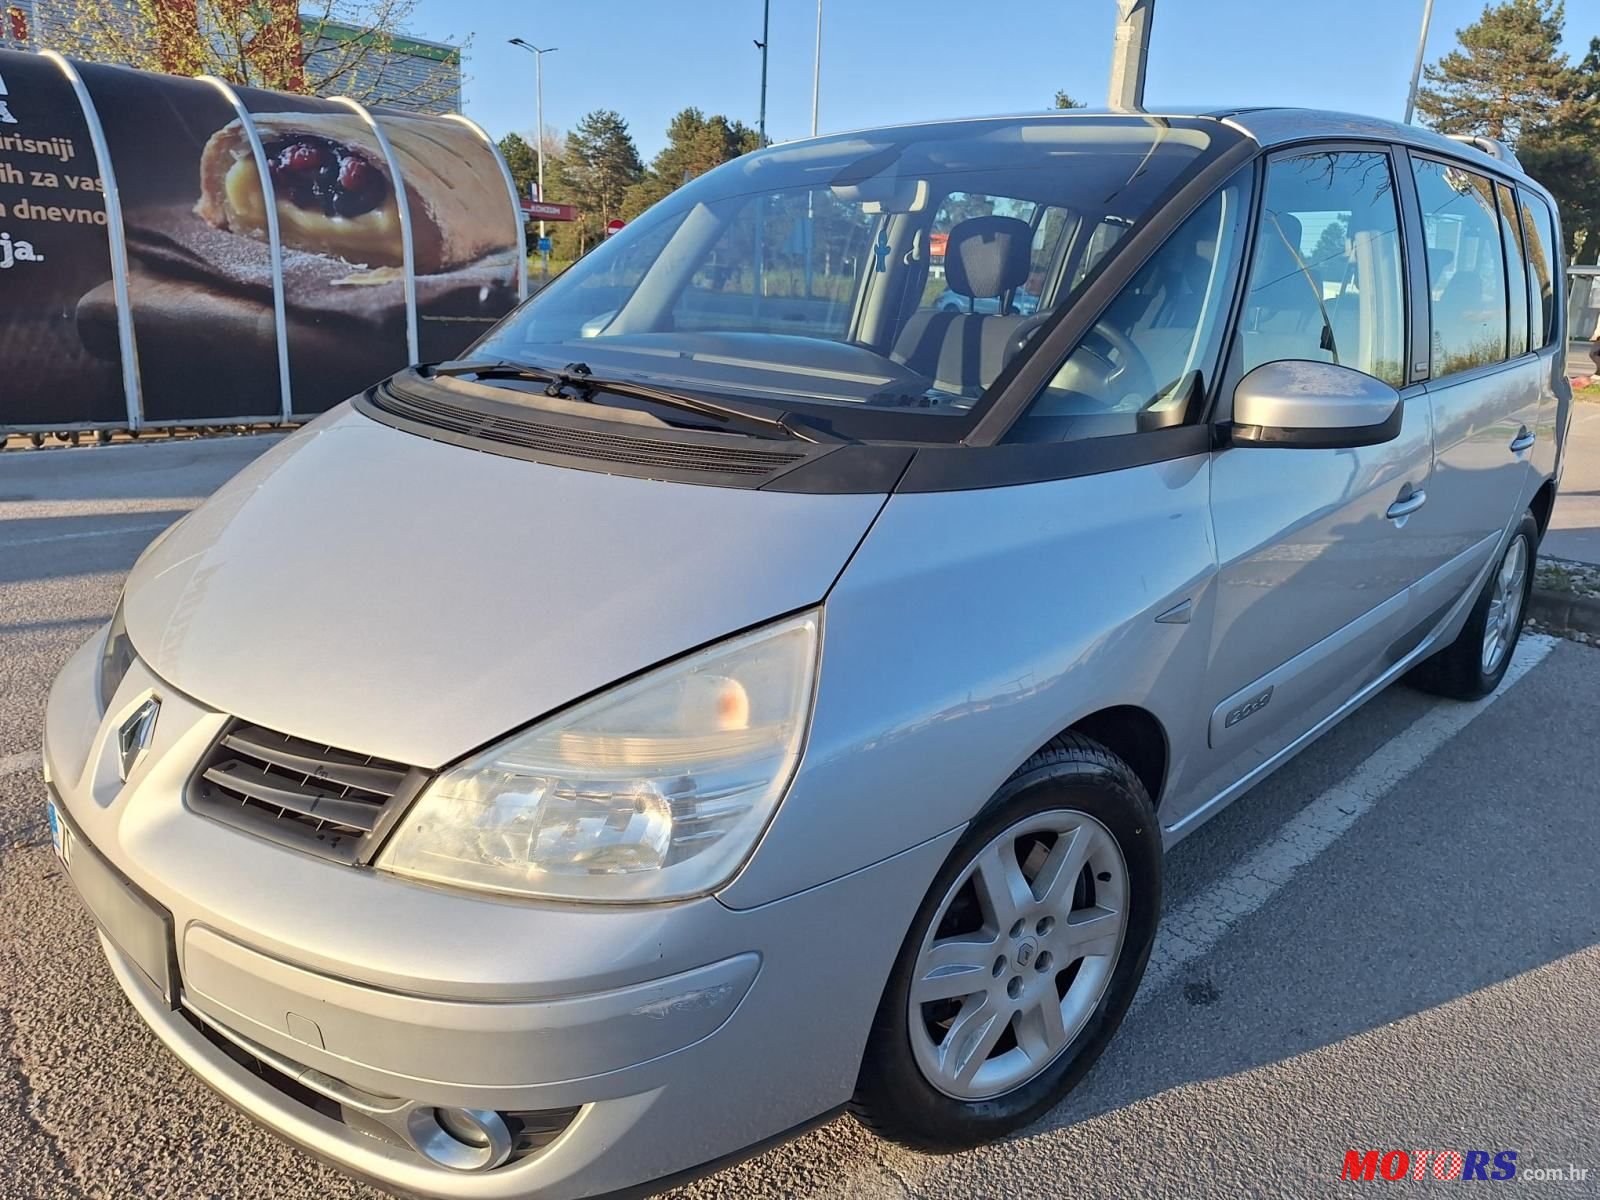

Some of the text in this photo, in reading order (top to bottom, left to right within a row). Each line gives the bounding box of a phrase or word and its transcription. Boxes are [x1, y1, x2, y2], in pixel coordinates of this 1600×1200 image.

[30, 171, 59, 188] za
[64, 174, 104, 193] vas
[13, 198, 108, 226] dnevno
[0, 232, 44, 269] ja.
